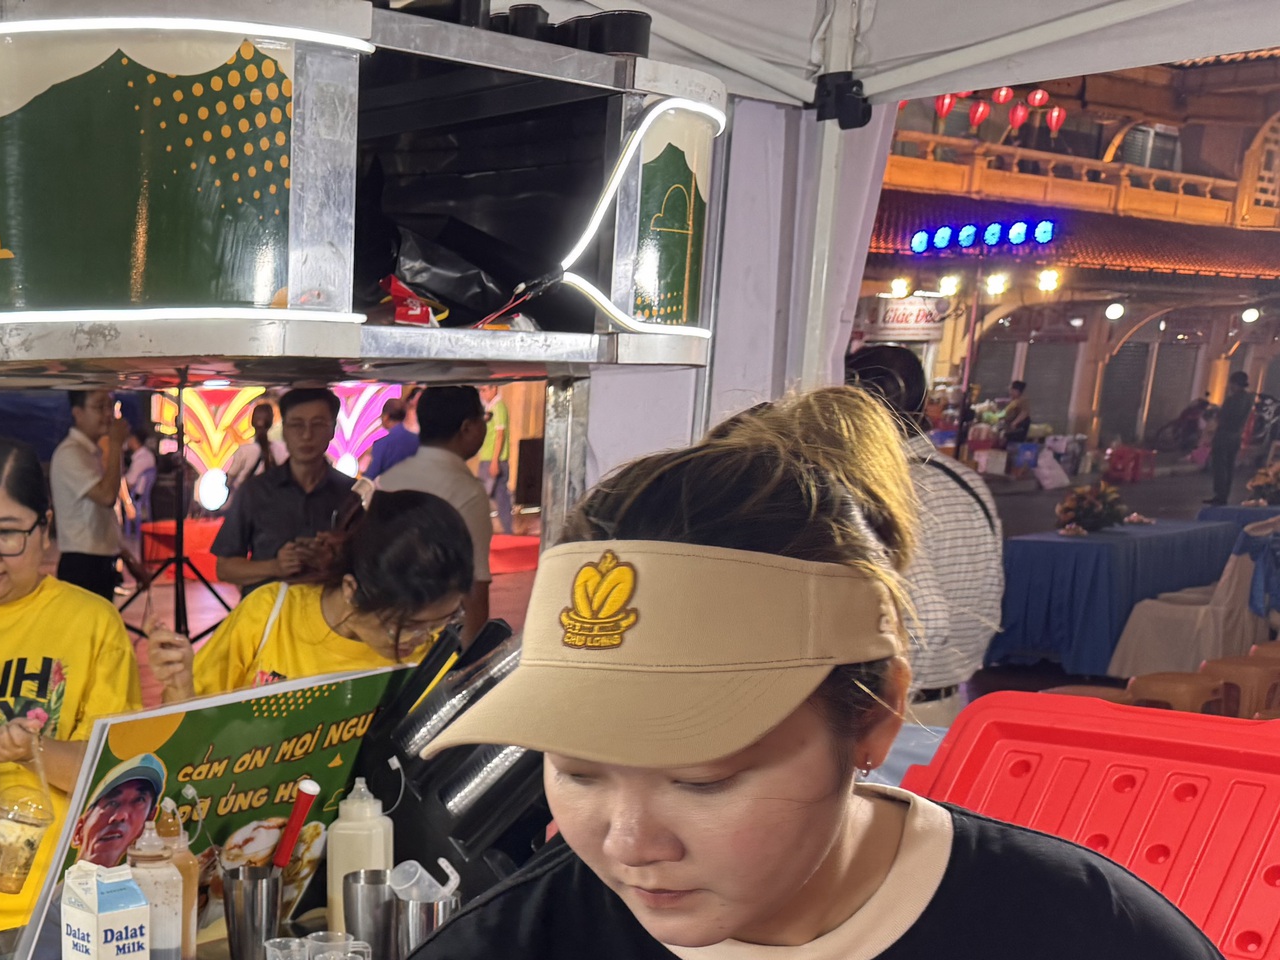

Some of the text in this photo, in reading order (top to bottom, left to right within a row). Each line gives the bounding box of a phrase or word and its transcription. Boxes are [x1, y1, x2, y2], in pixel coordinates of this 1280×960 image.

[66, 923, 91, 943] Dalat
[103, 924, 145, 944] Dalat
[72, 940, 91, 955] Milk
[115, 941, 145, 956] Milk
